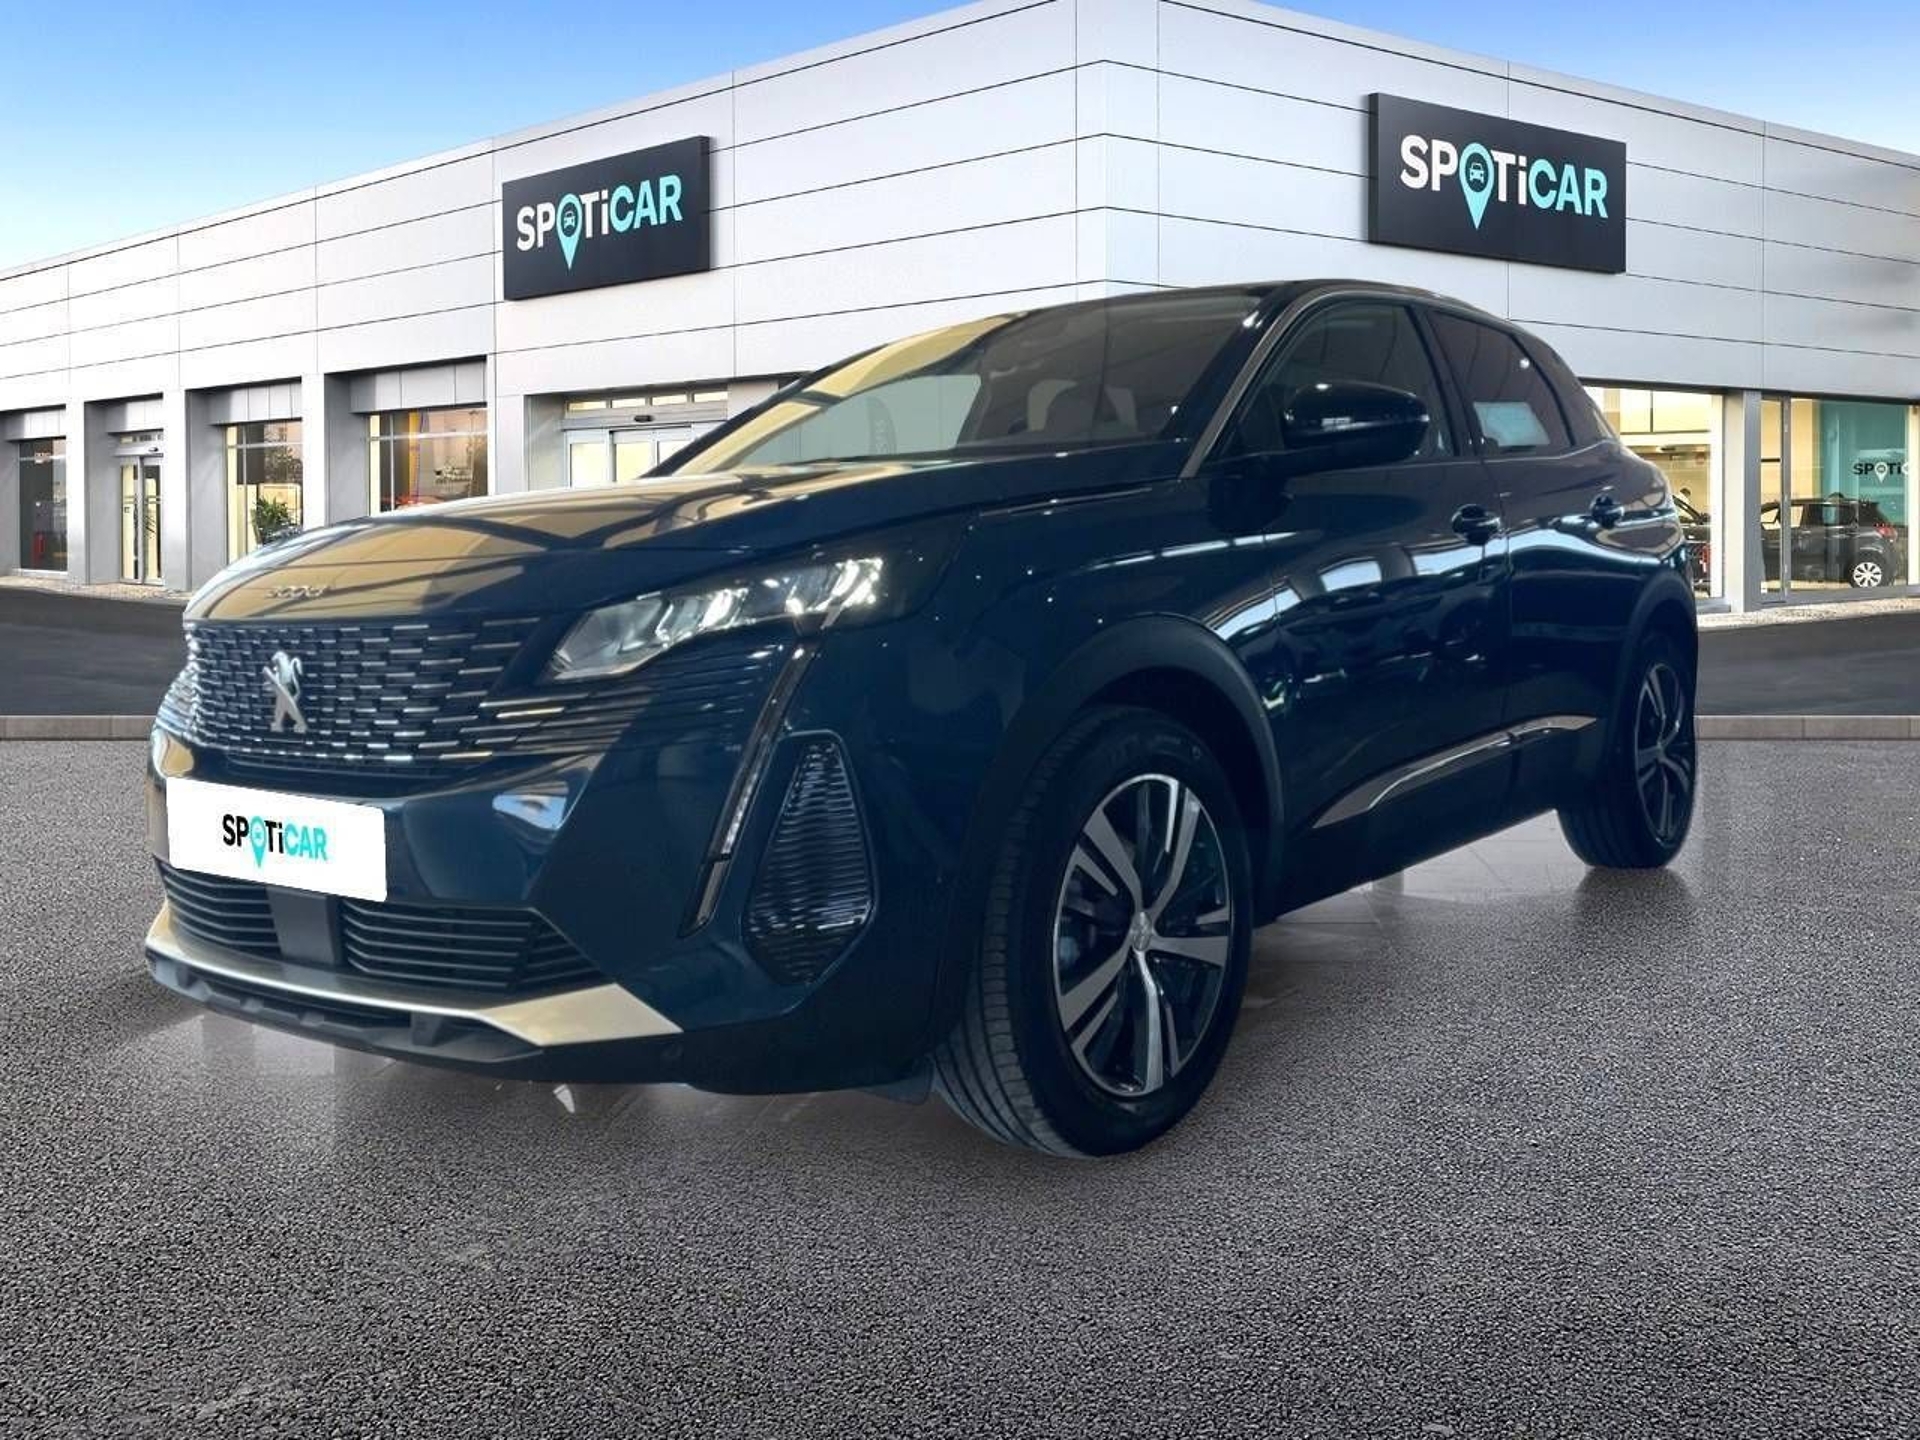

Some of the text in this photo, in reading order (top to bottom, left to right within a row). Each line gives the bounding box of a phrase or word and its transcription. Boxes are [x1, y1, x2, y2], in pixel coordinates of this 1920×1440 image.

[516, 174, 683, 271] SPOTiCAR
[1399, 134, 1609, 231] SPOTiCAR
[222, 813, 328, 868] SPOTiCAR
